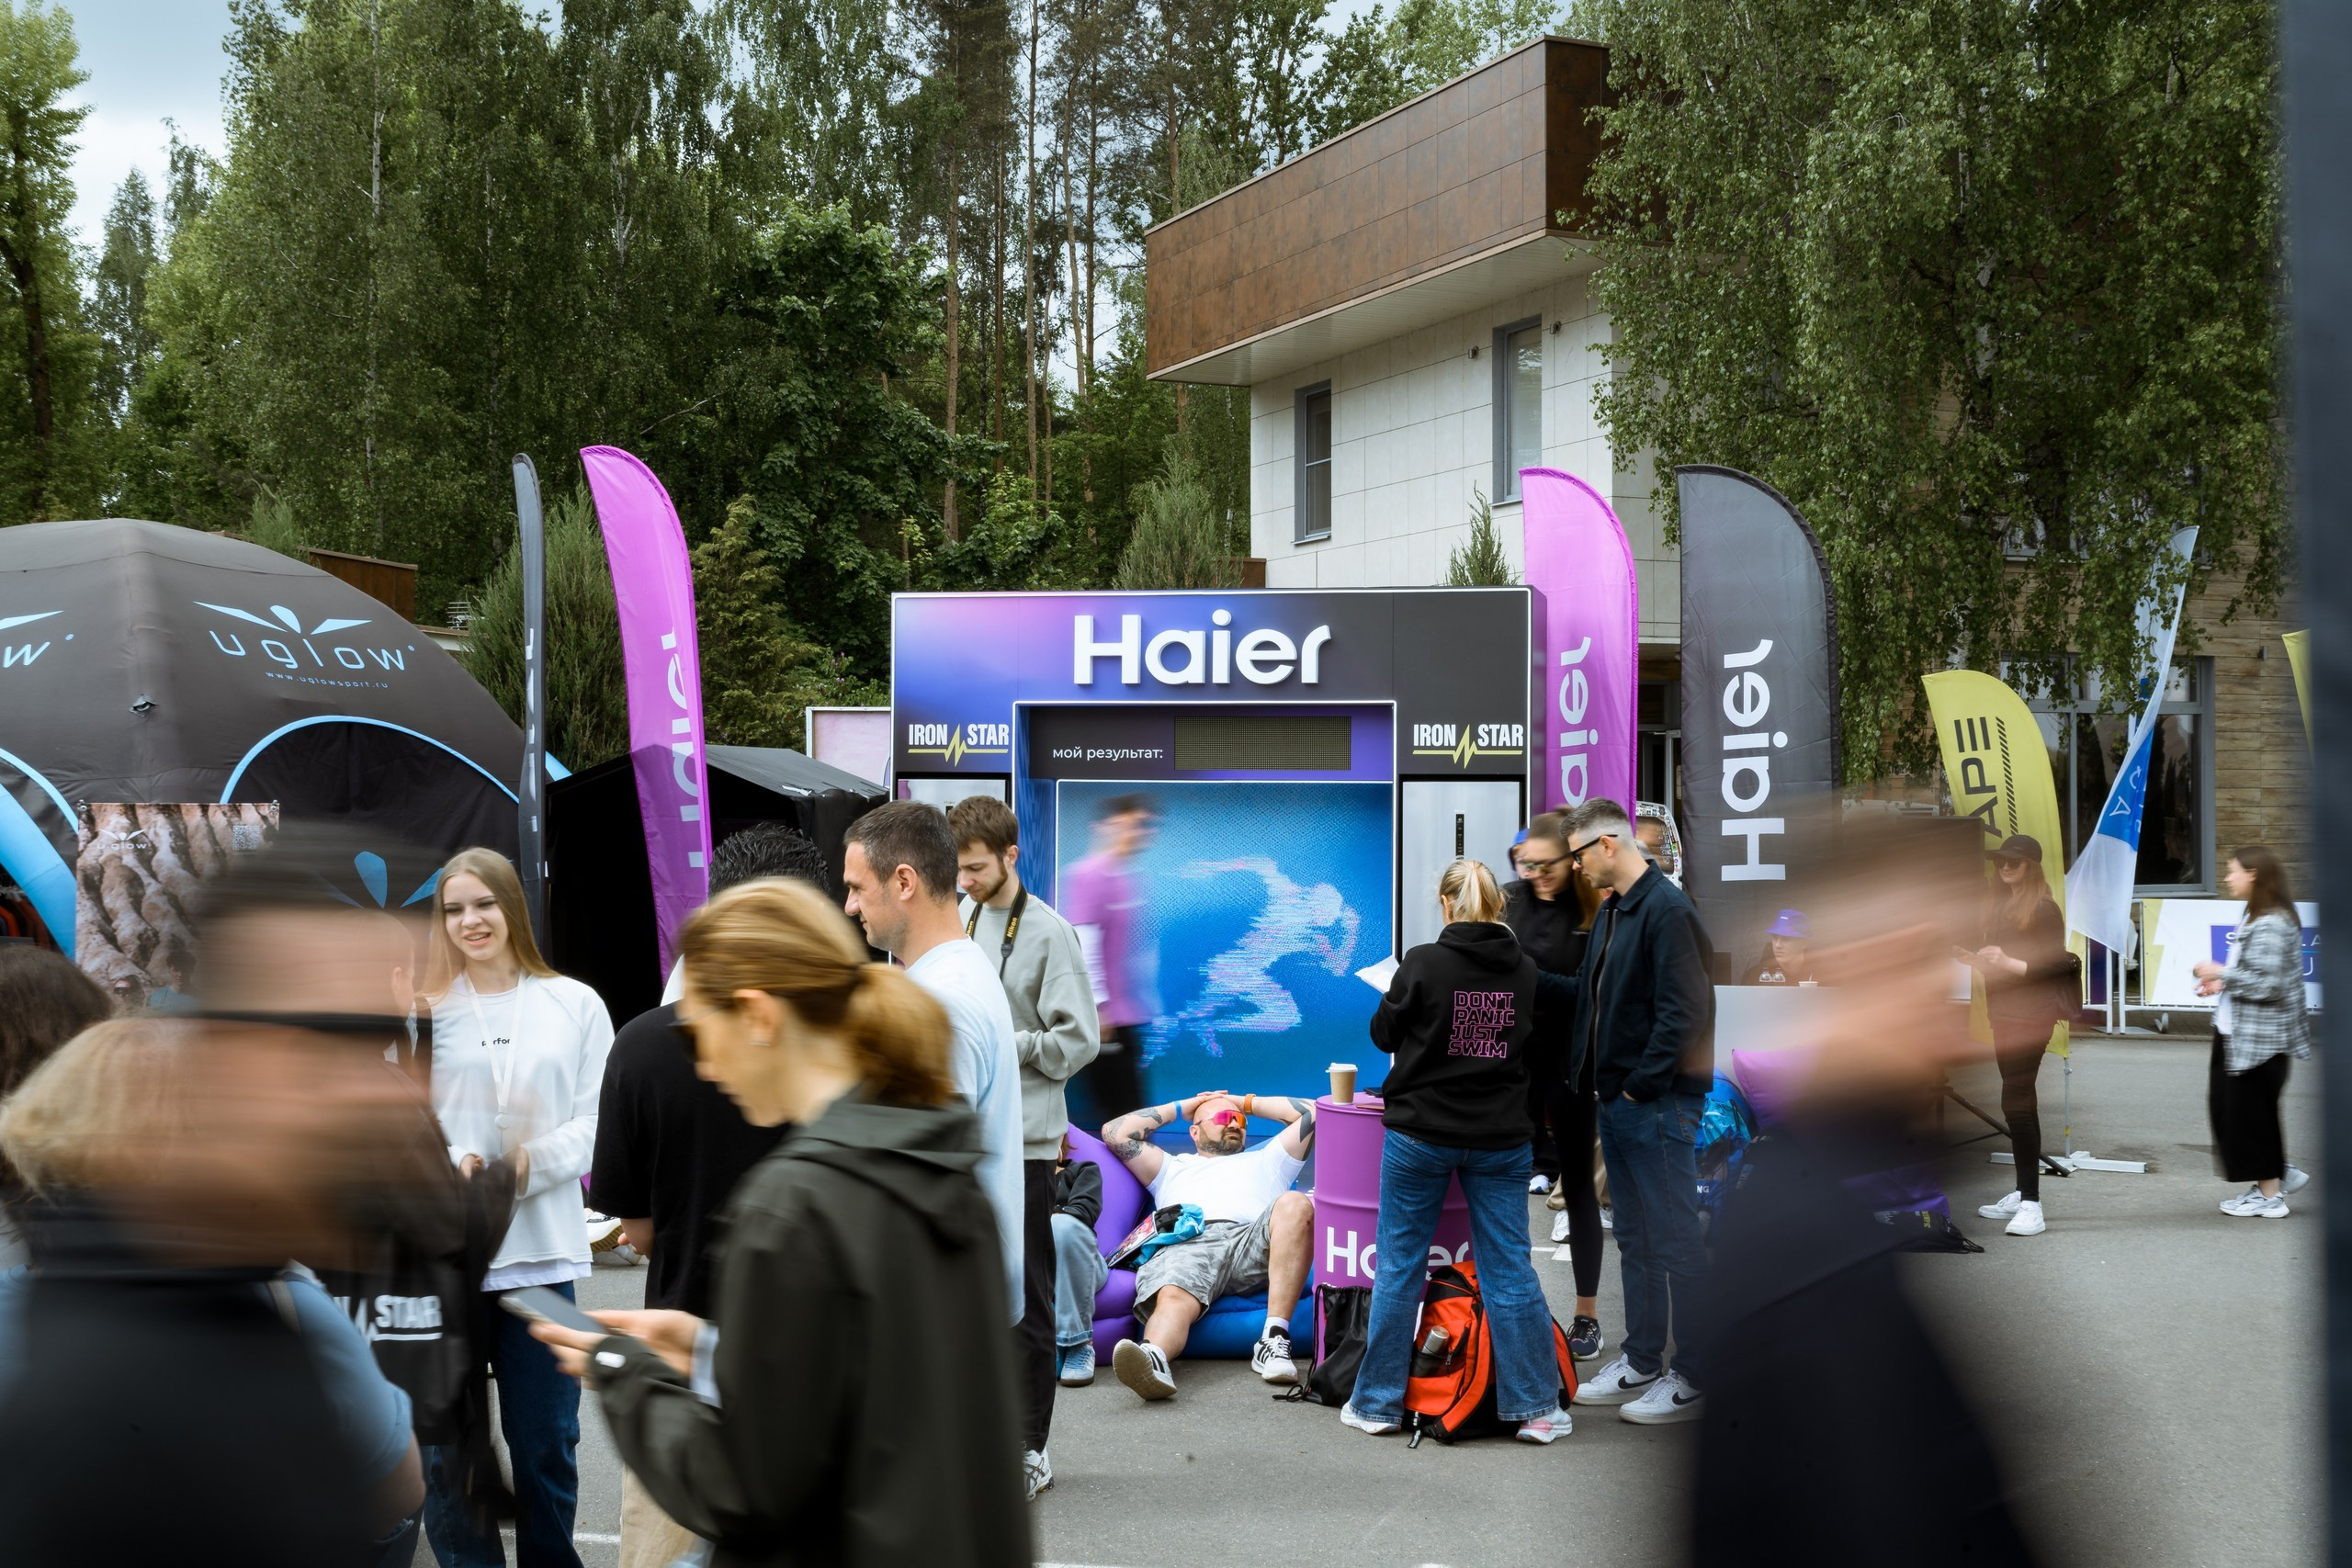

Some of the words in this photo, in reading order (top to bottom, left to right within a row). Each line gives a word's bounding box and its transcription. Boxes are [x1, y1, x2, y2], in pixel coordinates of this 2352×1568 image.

[209, 630, 405, 671] uglow
[1073, 608, 1331, 685] Haier
[266, 671, 390, 689] www.uglowsport.ru
[1559, 636, 1599, 807] aier
[908, 724, 948, 746] IRON
[967, 724, 1010, 746] STAR
[1413, 724, 1456, 747] IRON
[1477, 723, 1524, 747] STAR
[1052, 746, 1082, 759] мой
[1087, 748, 1164, 761] результат:
[1721, 638, 1789, 882] Haier
[1007, 918, 1018, 937] Nikon
[1453, 990, 1514, 1010] DON'T
[1453, 1008, 1515, 1026] PANIC
[1450, 1024, 1503, 1042] JUST
[1447, 1040, 1508, 1059] SWIM
[1696, 1184, 1710, 1194] NG
